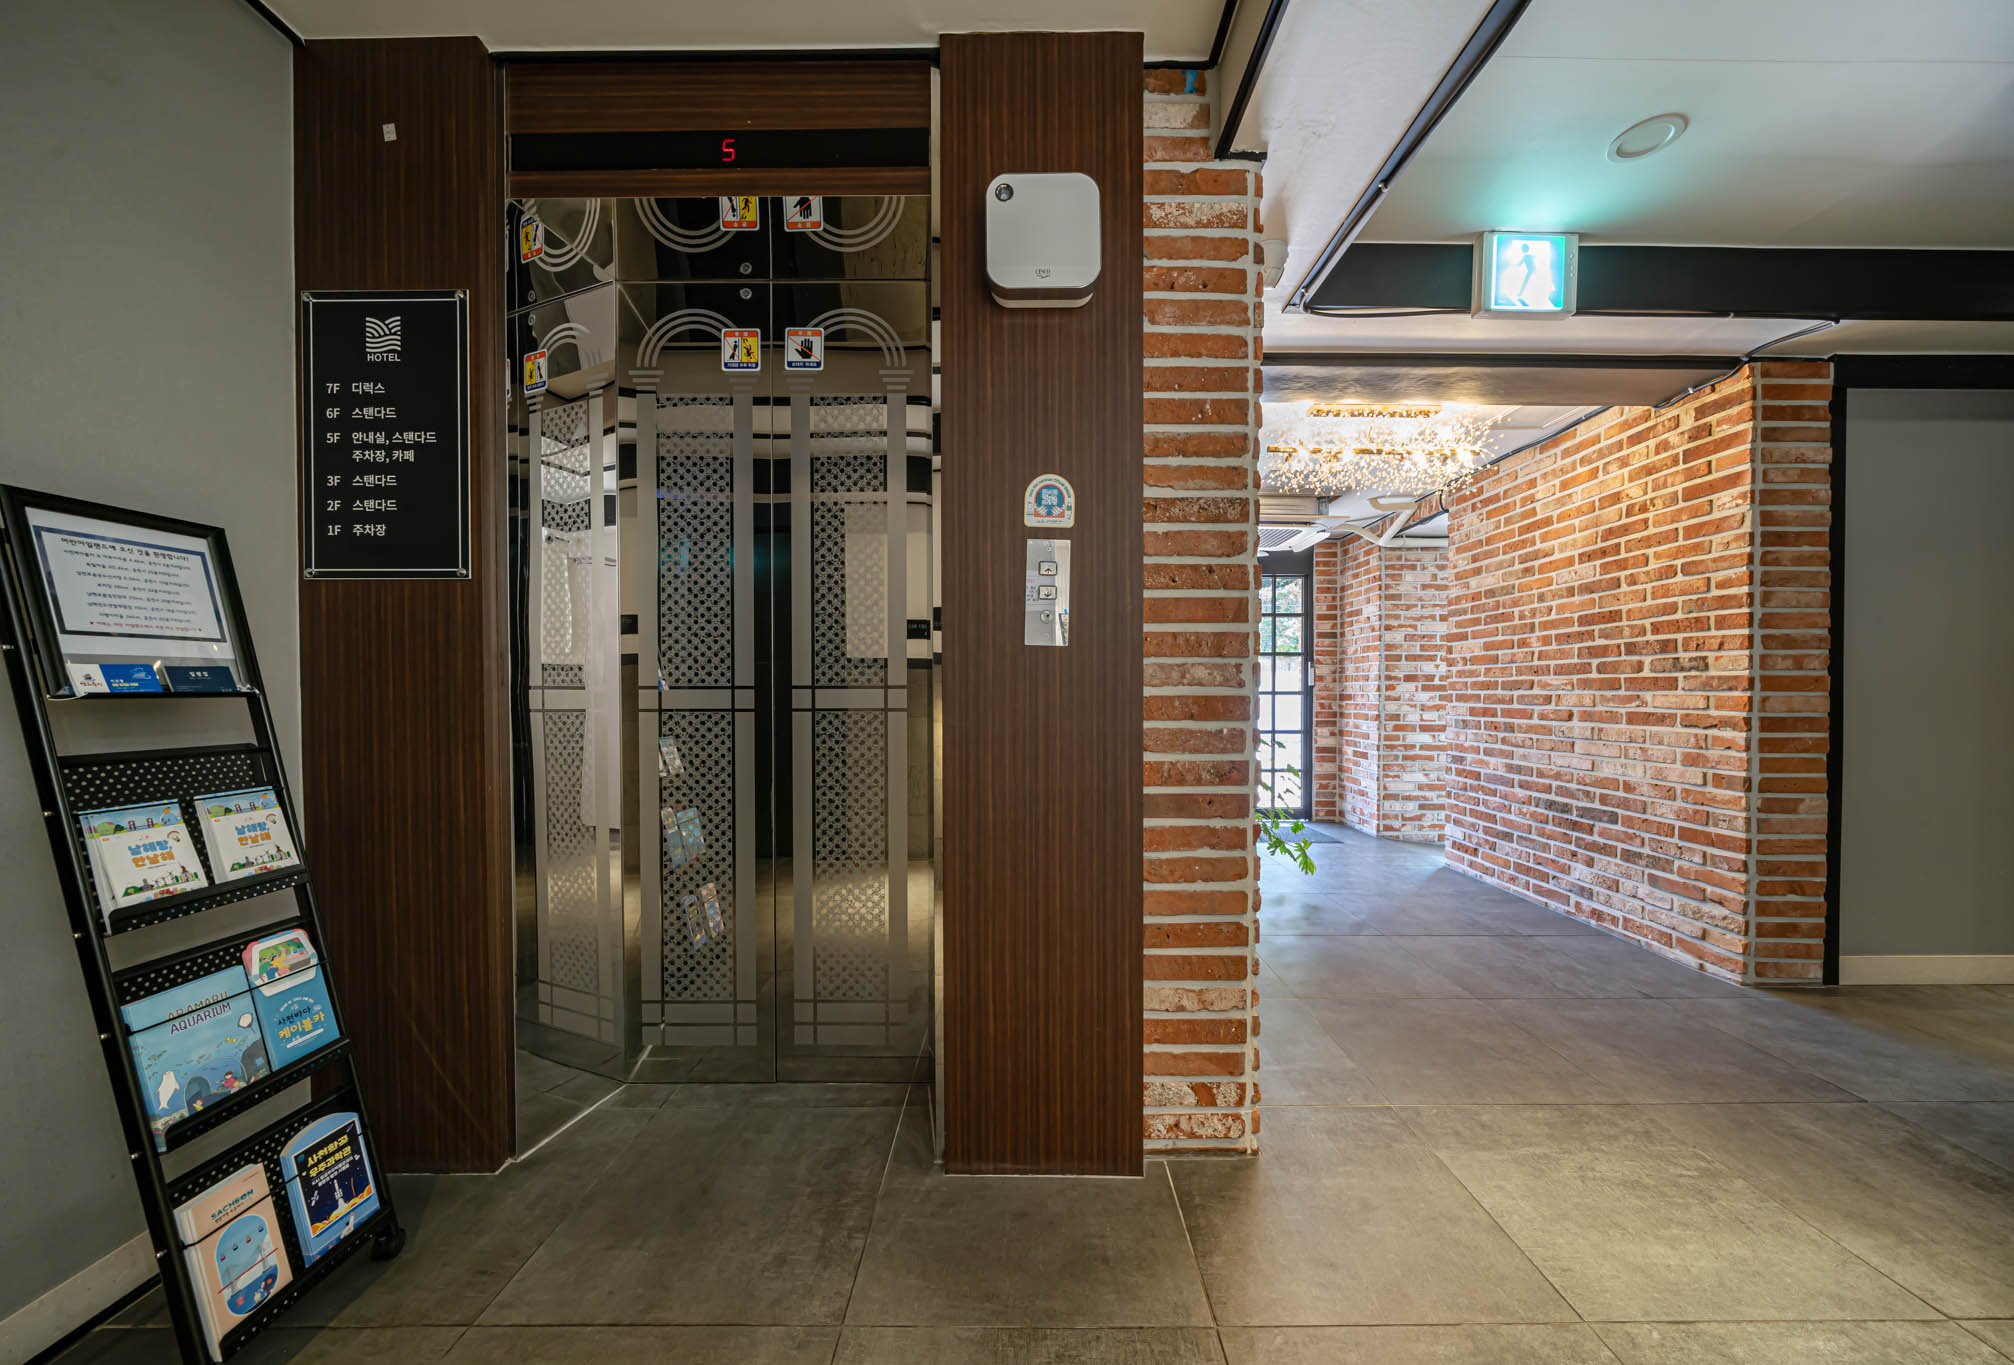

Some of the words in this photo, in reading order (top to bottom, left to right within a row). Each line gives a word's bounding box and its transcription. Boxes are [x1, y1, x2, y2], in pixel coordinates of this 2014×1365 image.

[721, 138, 736, 162] 5
[367, 353, 401, 362] HOTEL
[326, 383, 340, 394] 7F
[352, 383, 386, 394] 디럭스
[326, 408, 341, 419] 6F
[352, 407, 397, 419] 스탠다드
[326, 433, 341, 443] 5F
[352, 432, 390, 445] 안내실,
[392, 432, 437, 444] 스탠다드
[352, 450, 390, 463] 주차장,
[392, 450, 415, 462] 카페
[327, 476, 341, 487] 3F
[352, 475, 397, 487] 스탠다드
[327, 501, 341, 511] 2F
[352, 500, 398, 512] 스탠다드
[327, 525, 341, 535] 1F
[352, 524, 387, 537] 주차장
[170, 1001, 231, 1035] AQUARIUM
[278, 1010, 326, 1039] 케이블카
